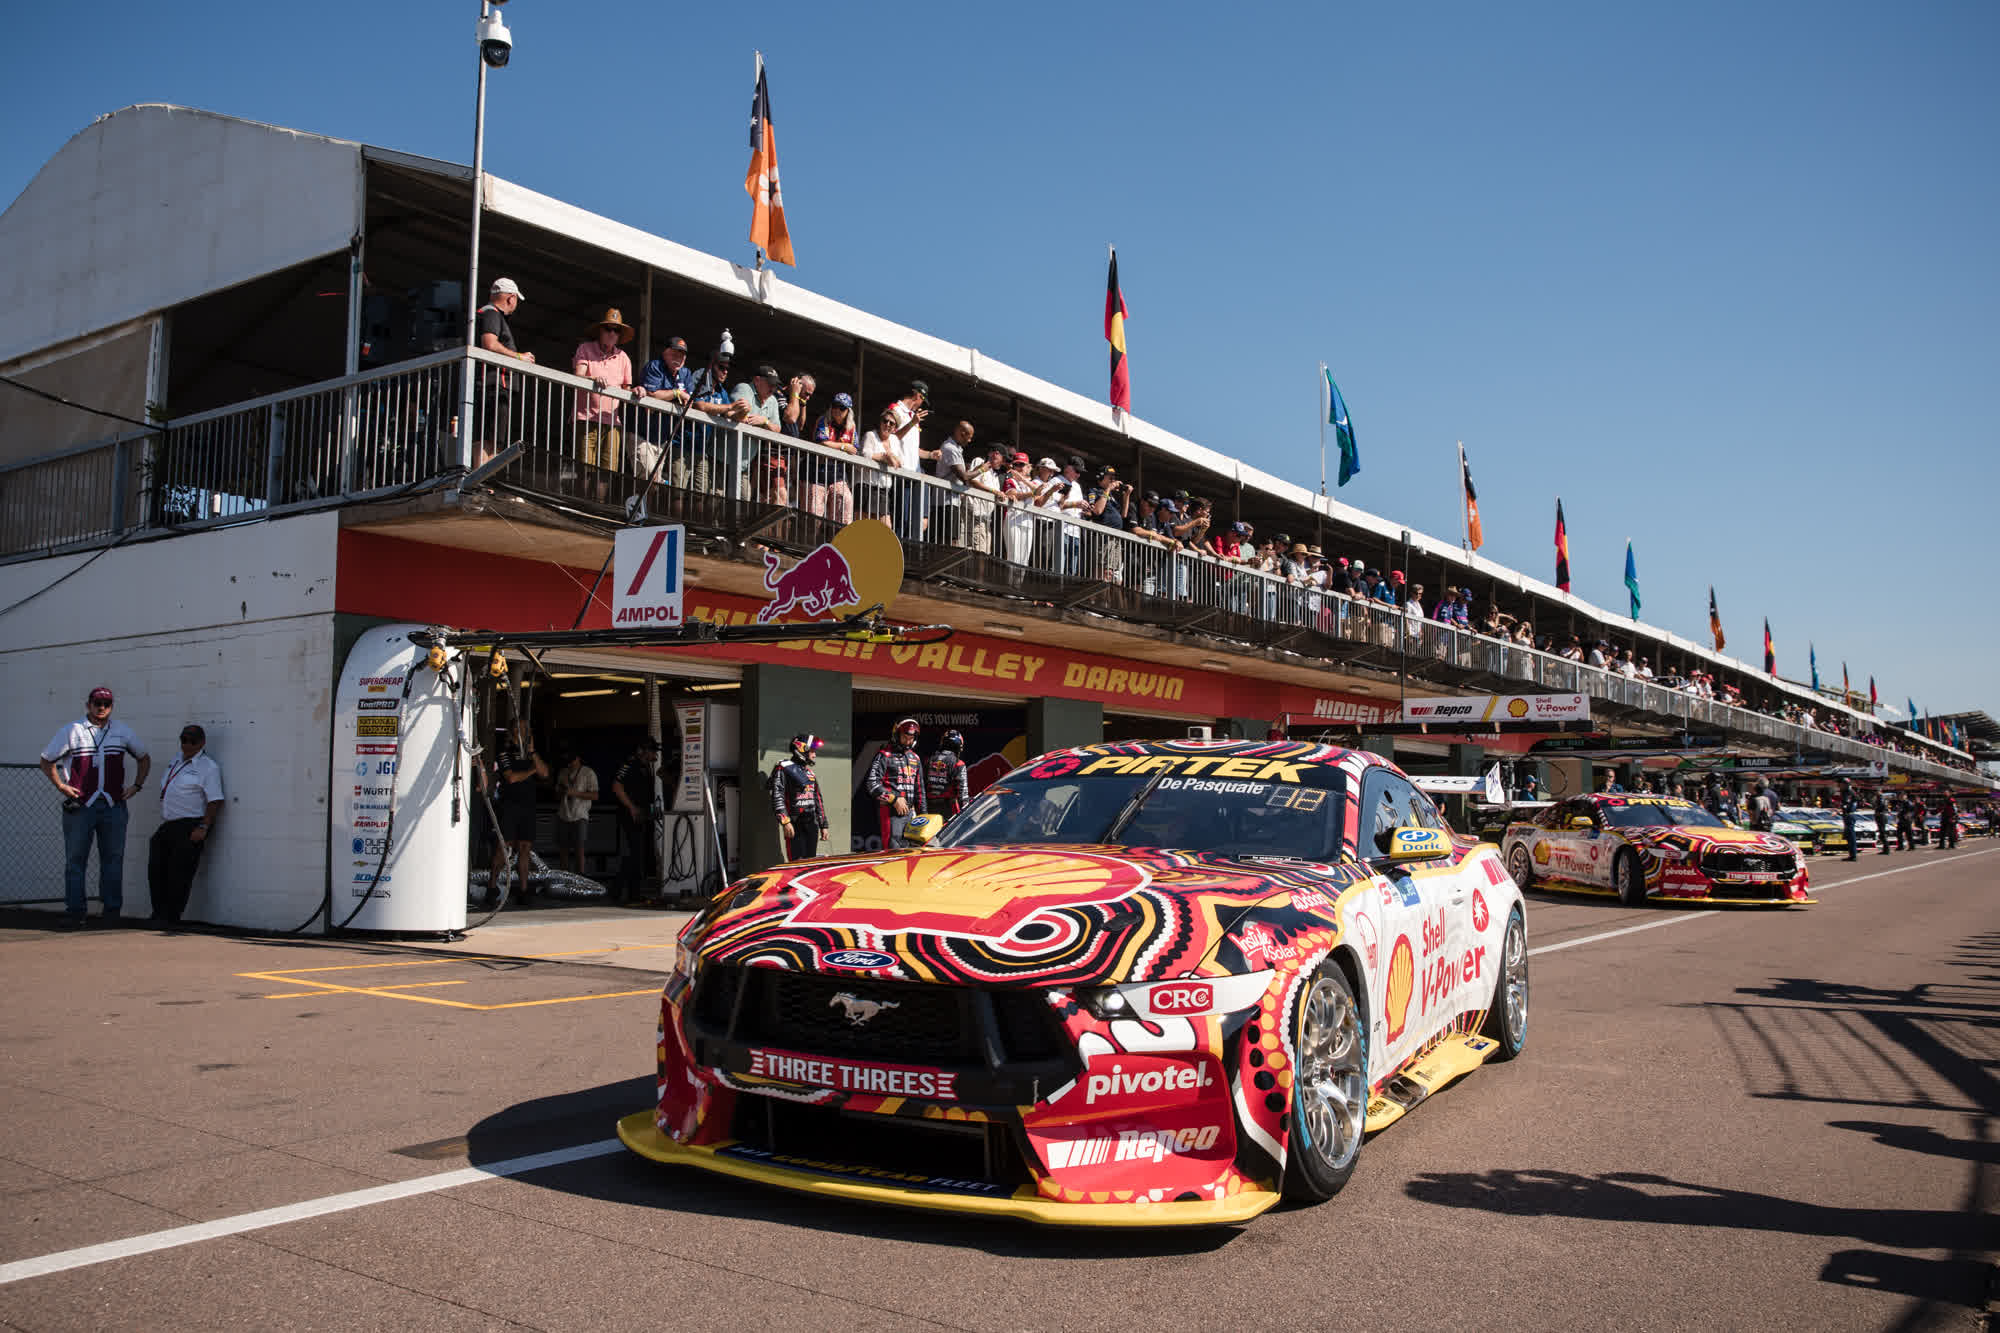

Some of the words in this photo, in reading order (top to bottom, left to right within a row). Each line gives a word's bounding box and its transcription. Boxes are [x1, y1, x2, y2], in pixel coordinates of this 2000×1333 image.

[615, 606, 680, 623] AMPOL
[889, 636, 1046, 682] VALLEY
[1063, 662, 1185, 701] DARWIN
[359, 676, 404, 687] SUPERCHEAP
[1535, 696, 1552, 704] Shell
[1535, 704, 1578, 713] V-Power
[950, 712, 979, 727] WINGS
[1313, 698, 1380, 725] HIDDEN
[1433, 704, 1473, 717] Repco
[1077, 755, 1320, 783] PIRTEK
[1157, 777, 1183, 791] De
[1402, 842, 1444, 852] Doric
[1422, 906, 1446, 958] Shell
[1230, 927, 1271, 958] Instyle
[834, 950, 882, 968] Ford
[1267, 943, 1298, 961] Solar
[1421, 945, 1486, 1017] V-Power
[1152, 988, 1211, 1010] CRC
[765, 1052, 835, 1086] THREE
[838, 1065, 936, 1097] THREES
[1113, 1125, 1221, 1163] Repco
